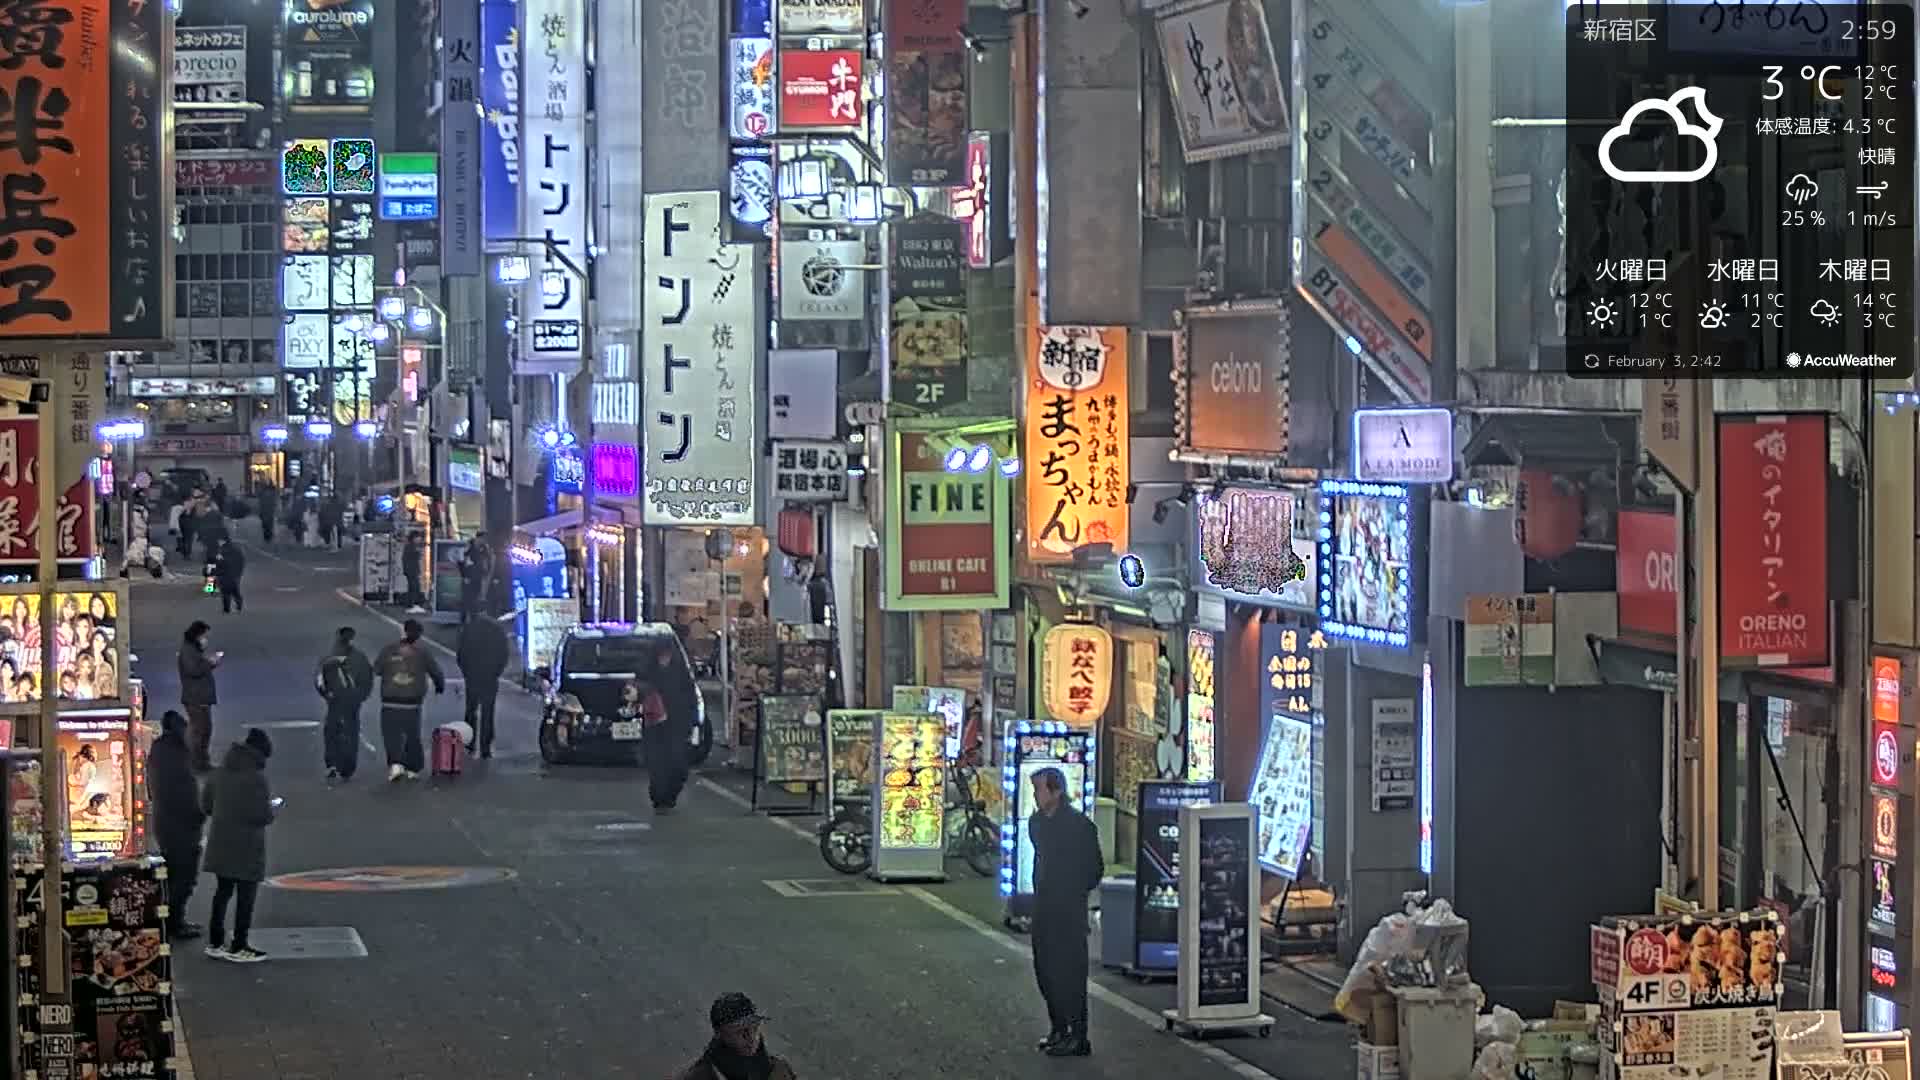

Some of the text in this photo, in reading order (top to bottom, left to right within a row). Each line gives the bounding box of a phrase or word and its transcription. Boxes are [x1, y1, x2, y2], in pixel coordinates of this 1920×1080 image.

[542, 14, 569, 121] 焼とん酒場
[830, 57, 857, 120] 牛門
[539, 134, 570, 310] トントン
[900, 256, 958, 270] Walton's
[658, 207, 693, 460] トントン
[916, 384, 945, 402] 2F
[778, 448, 842, 469] 酒場心
[1039, 395, 1083, 543] まっちゃん
[778, 474, 841, 491] 新宿本店
[911, 484, 984, 511] FINE
[1754, 430, 1787, 602] 俺のイタリアン
[909, 558, 988, 573] ONLINE CAFE
[1645, 551, 1677, 592] OR
[1739, 614, 1806, 631] ORENO
[1738, 634, 1807, 649] ITALIAN
[1627, 981, 1660, 1003] 4F
[40, 1004, 71, 1024] NERO
[42, 1034, 73, 1056] NERO
